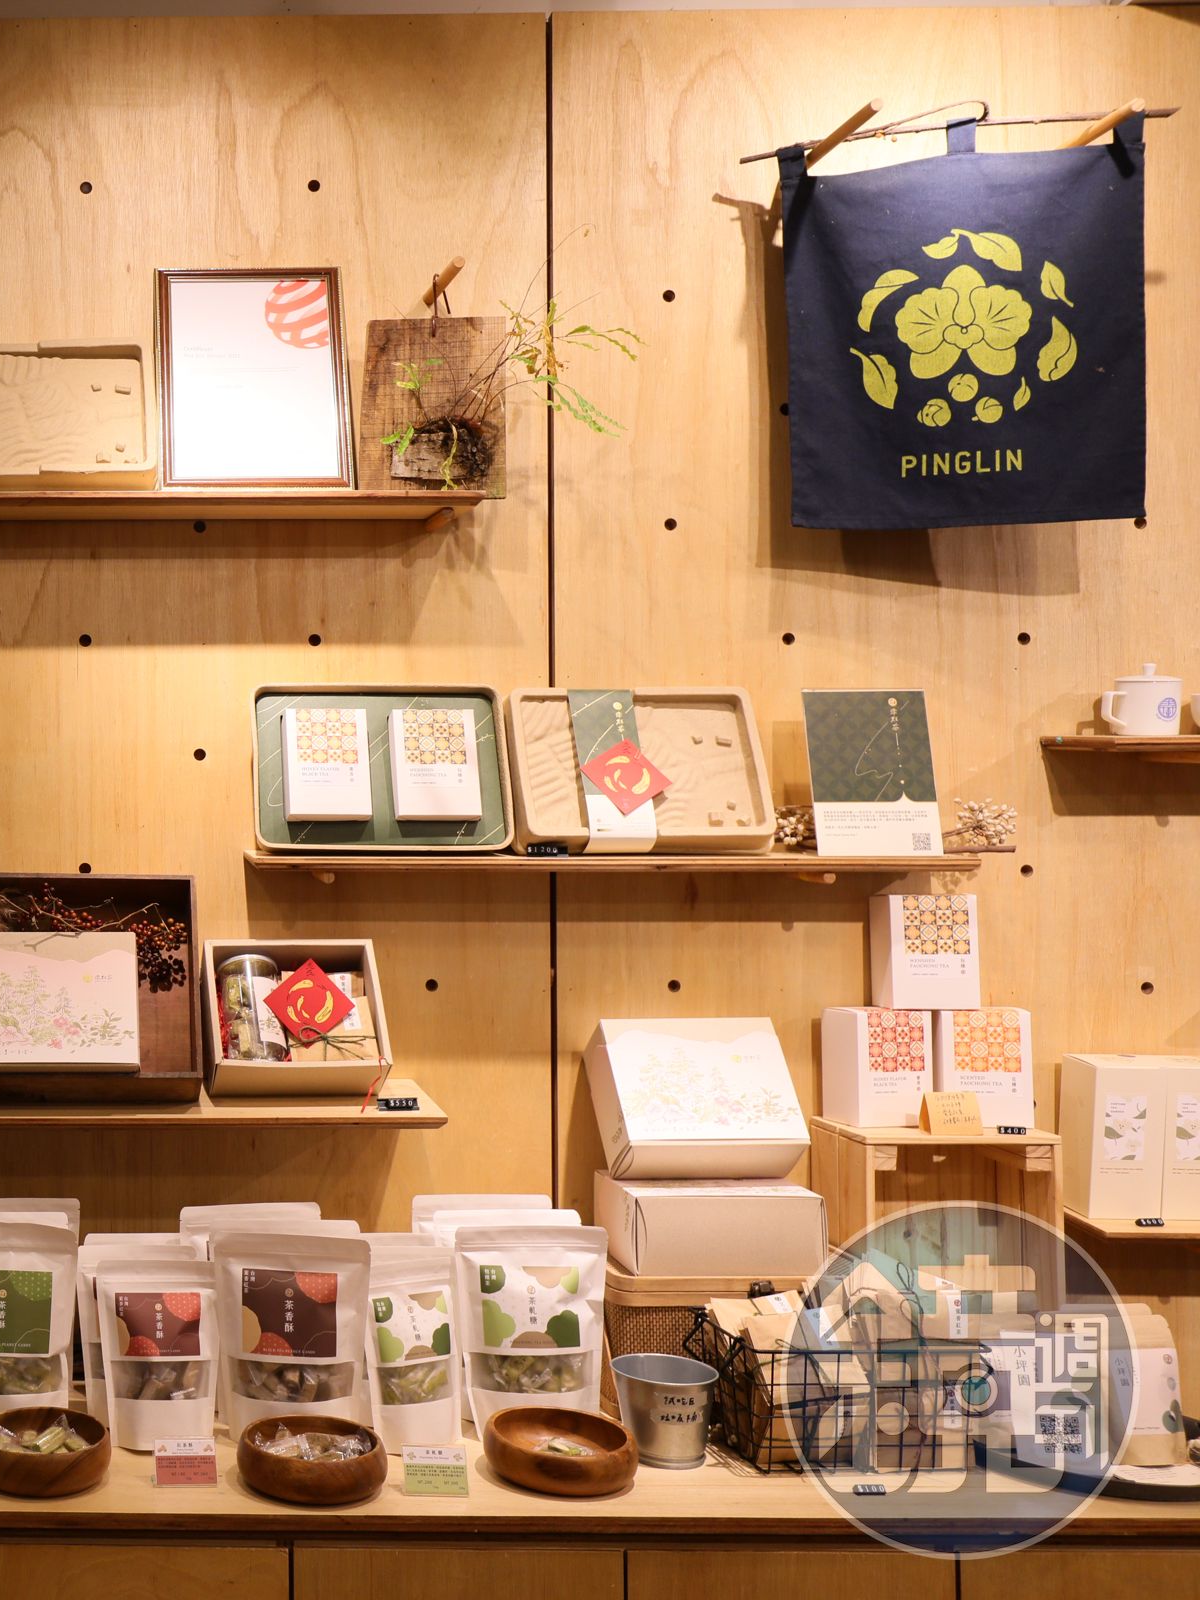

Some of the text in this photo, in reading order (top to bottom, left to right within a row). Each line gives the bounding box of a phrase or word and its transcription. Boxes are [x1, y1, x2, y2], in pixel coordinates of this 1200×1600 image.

[900, 448, 1023, 478] PINGLIN
[1001, 1127, 1026, 1135] $400
[155, 1312, 164, 1340] 茶香酥
[284, 1300, 295, 1333] 茶香酥
[858, 1485, 885, 1493] $100
